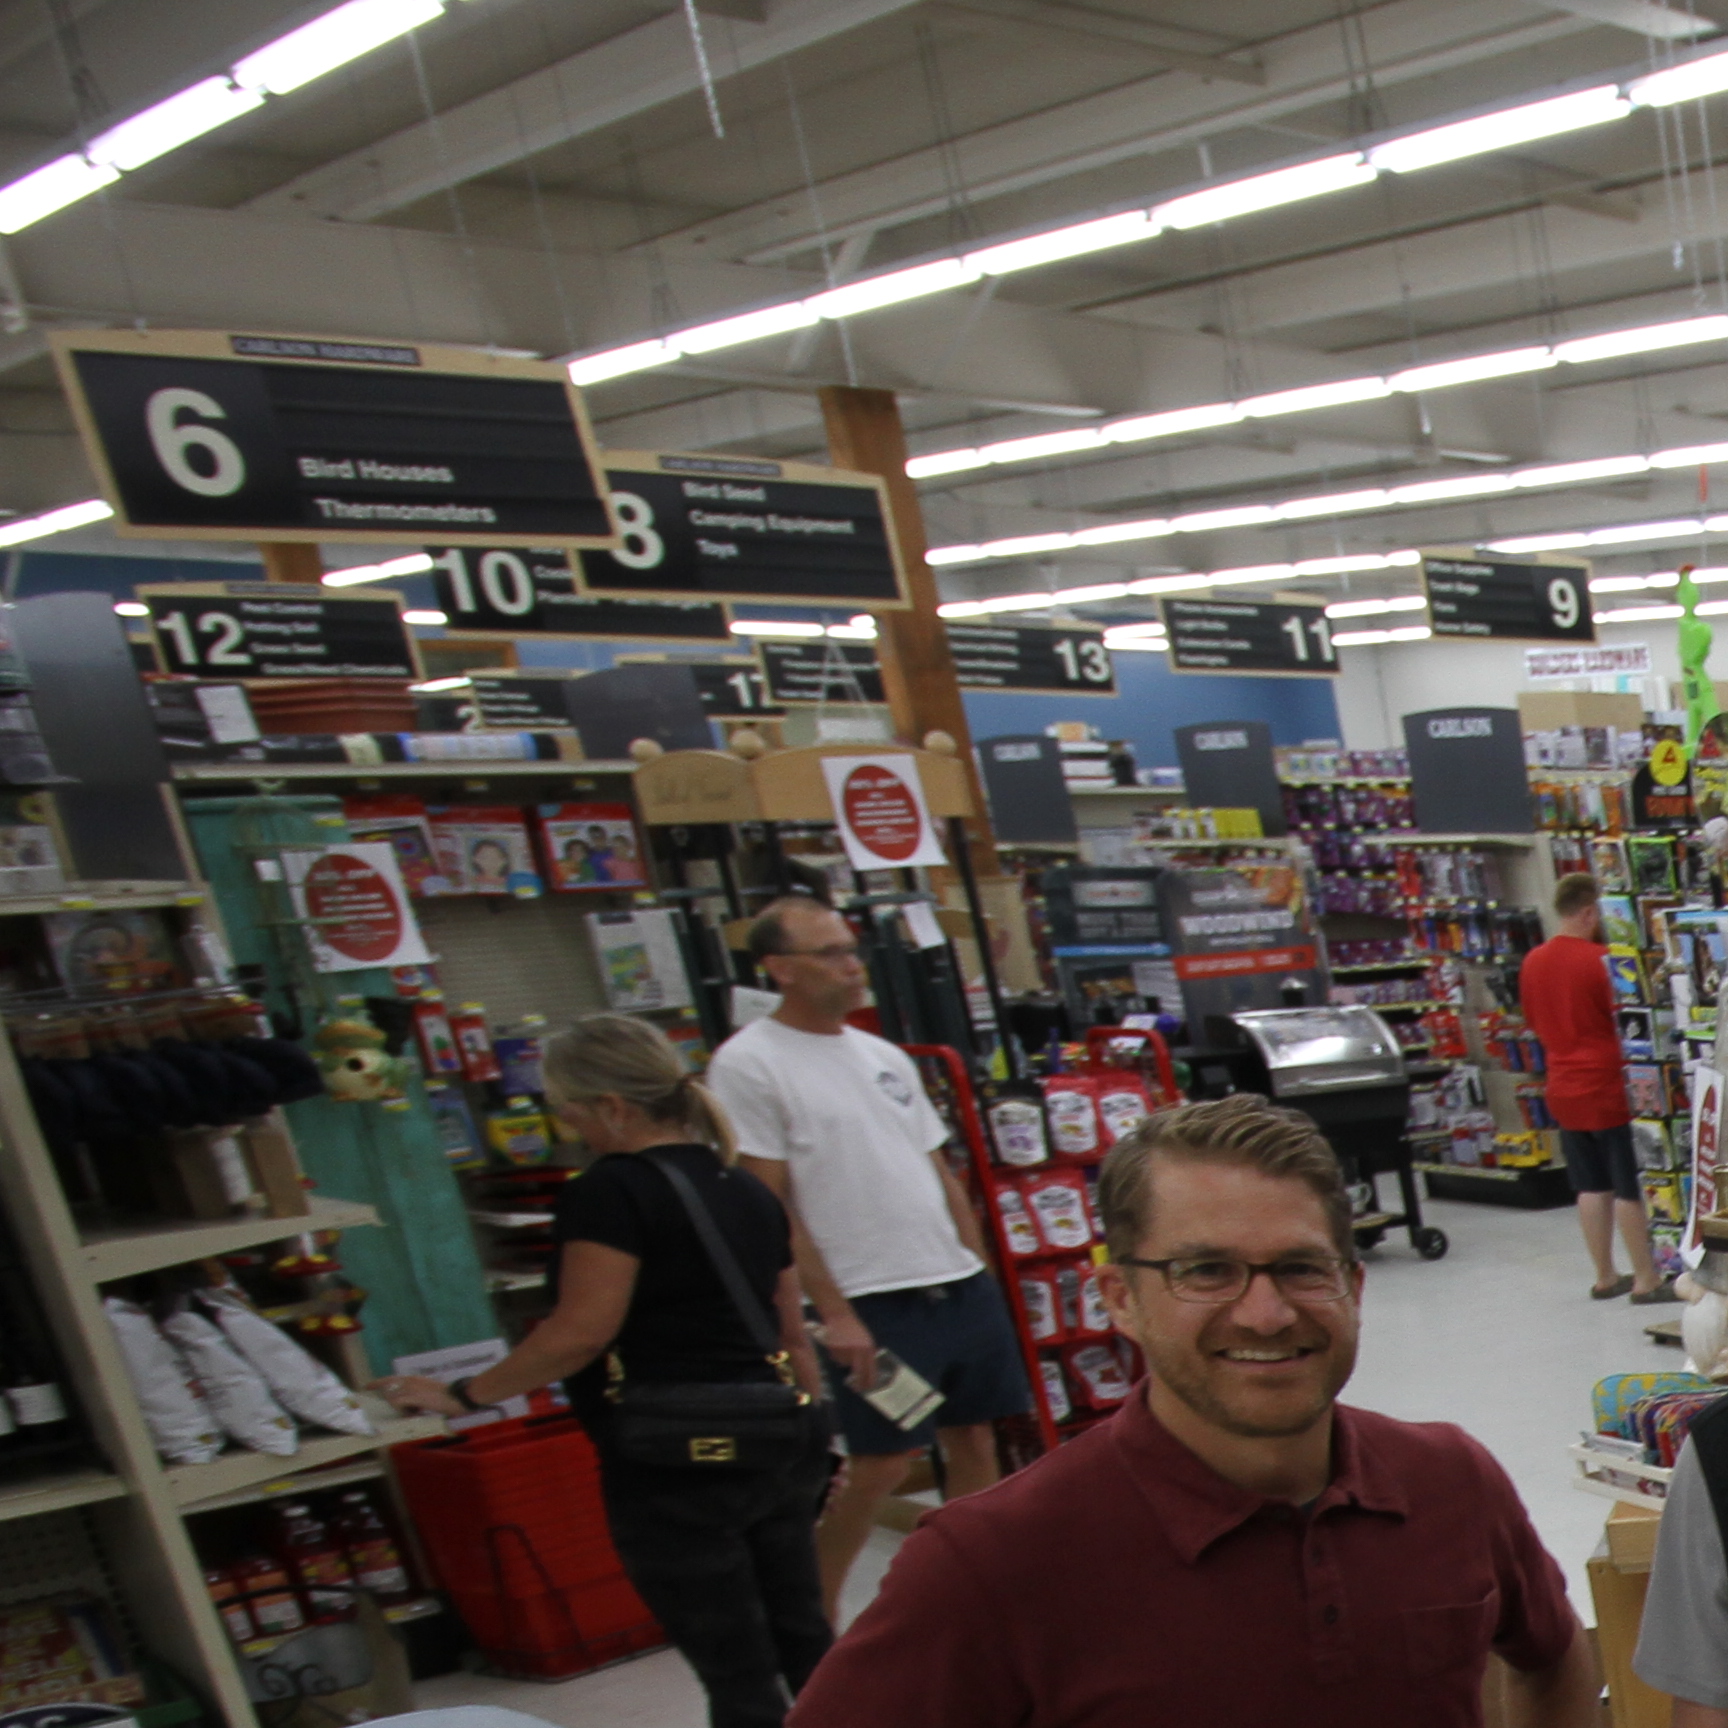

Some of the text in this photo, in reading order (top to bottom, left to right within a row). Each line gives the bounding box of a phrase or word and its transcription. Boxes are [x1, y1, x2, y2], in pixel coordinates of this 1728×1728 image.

[146, 387, 246, 497] 6
[298, 457, 455, 482] Bird Houses
[682, 482, 766, 501] Bird Seed
[313, 497, 498, 523] Thermometers
[610, 492, 664, 569] 8
[689, 509, 855, 535] Camping Equipment
[696, 538, 739, 559] Toys
[434, 548, 535, 615] 10
[1549, 578, 1579, 628] 9
[156, 611, 253, 665] 12
[1053, 638, 1111, 682] 13
[1282, 616, 1335, 662] 11
[1428, 717, 1493, 738] CARLSON
